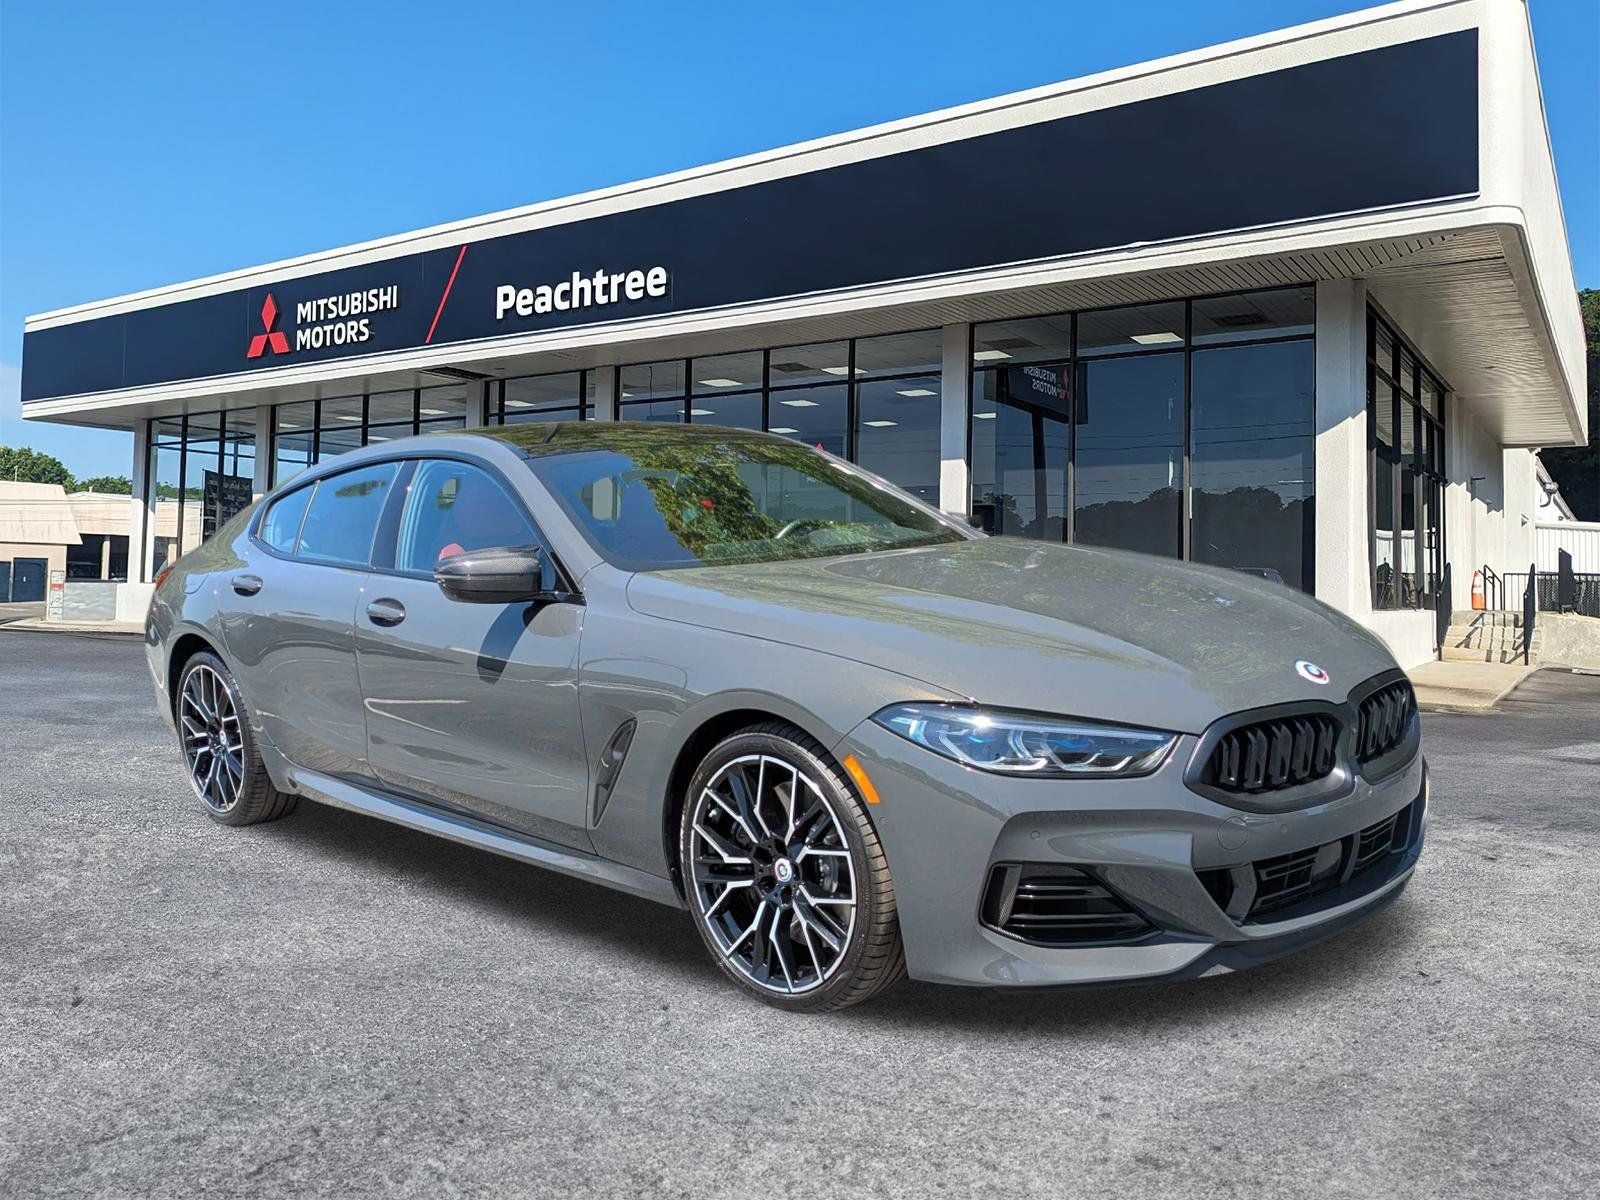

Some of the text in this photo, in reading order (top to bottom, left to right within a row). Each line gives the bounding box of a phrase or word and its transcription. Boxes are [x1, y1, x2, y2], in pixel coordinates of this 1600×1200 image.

[296, 285, 398, 325] MITSUBISHI
[495, 266, 667, 320] Peachtree
[296, 318, 370, 351] MOTORS
